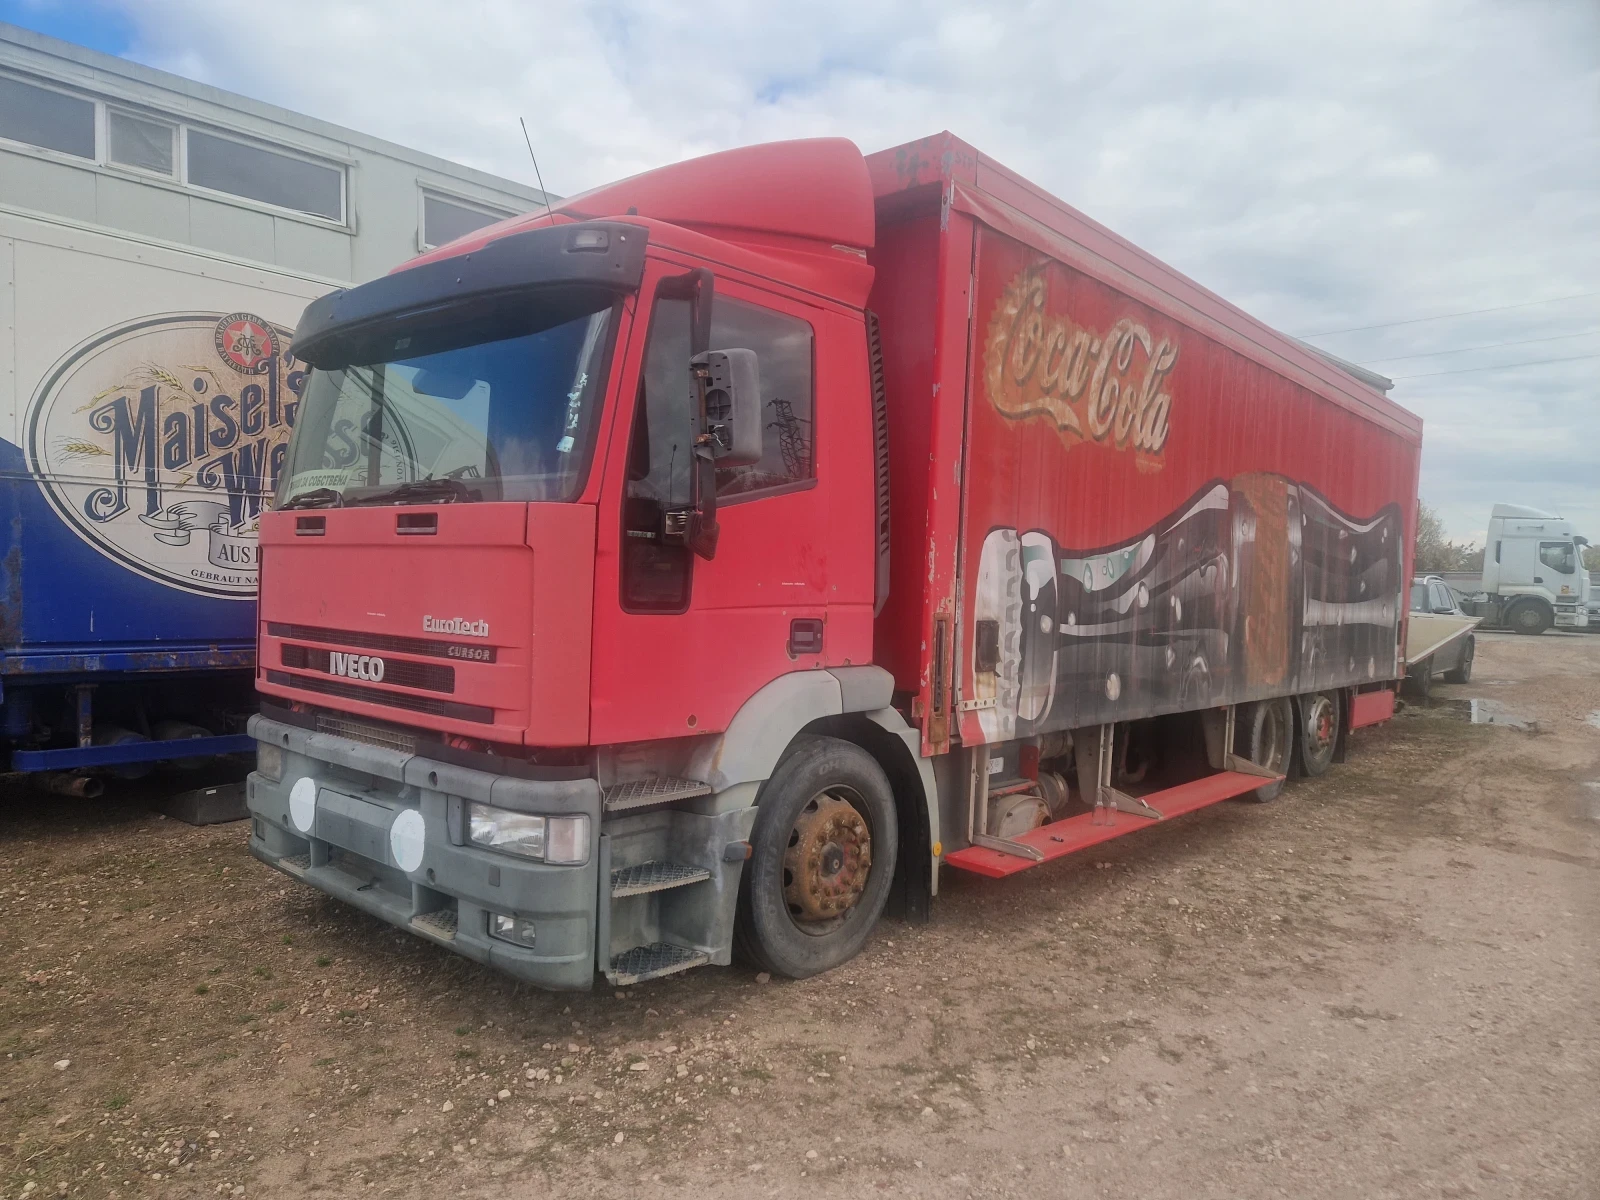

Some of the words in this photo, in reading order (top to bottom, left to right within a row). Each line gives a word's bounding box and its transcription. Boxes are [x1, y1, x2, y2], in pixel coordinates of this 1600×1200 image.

[217, 544, 251, 564] AUS
[190, 569, 242, 584] GEBRAUT
[423, 615, 489, 637] EuroTech
[447, 646, 490, 660] CURSOR
[330, 651, 384, 682] IVECO
